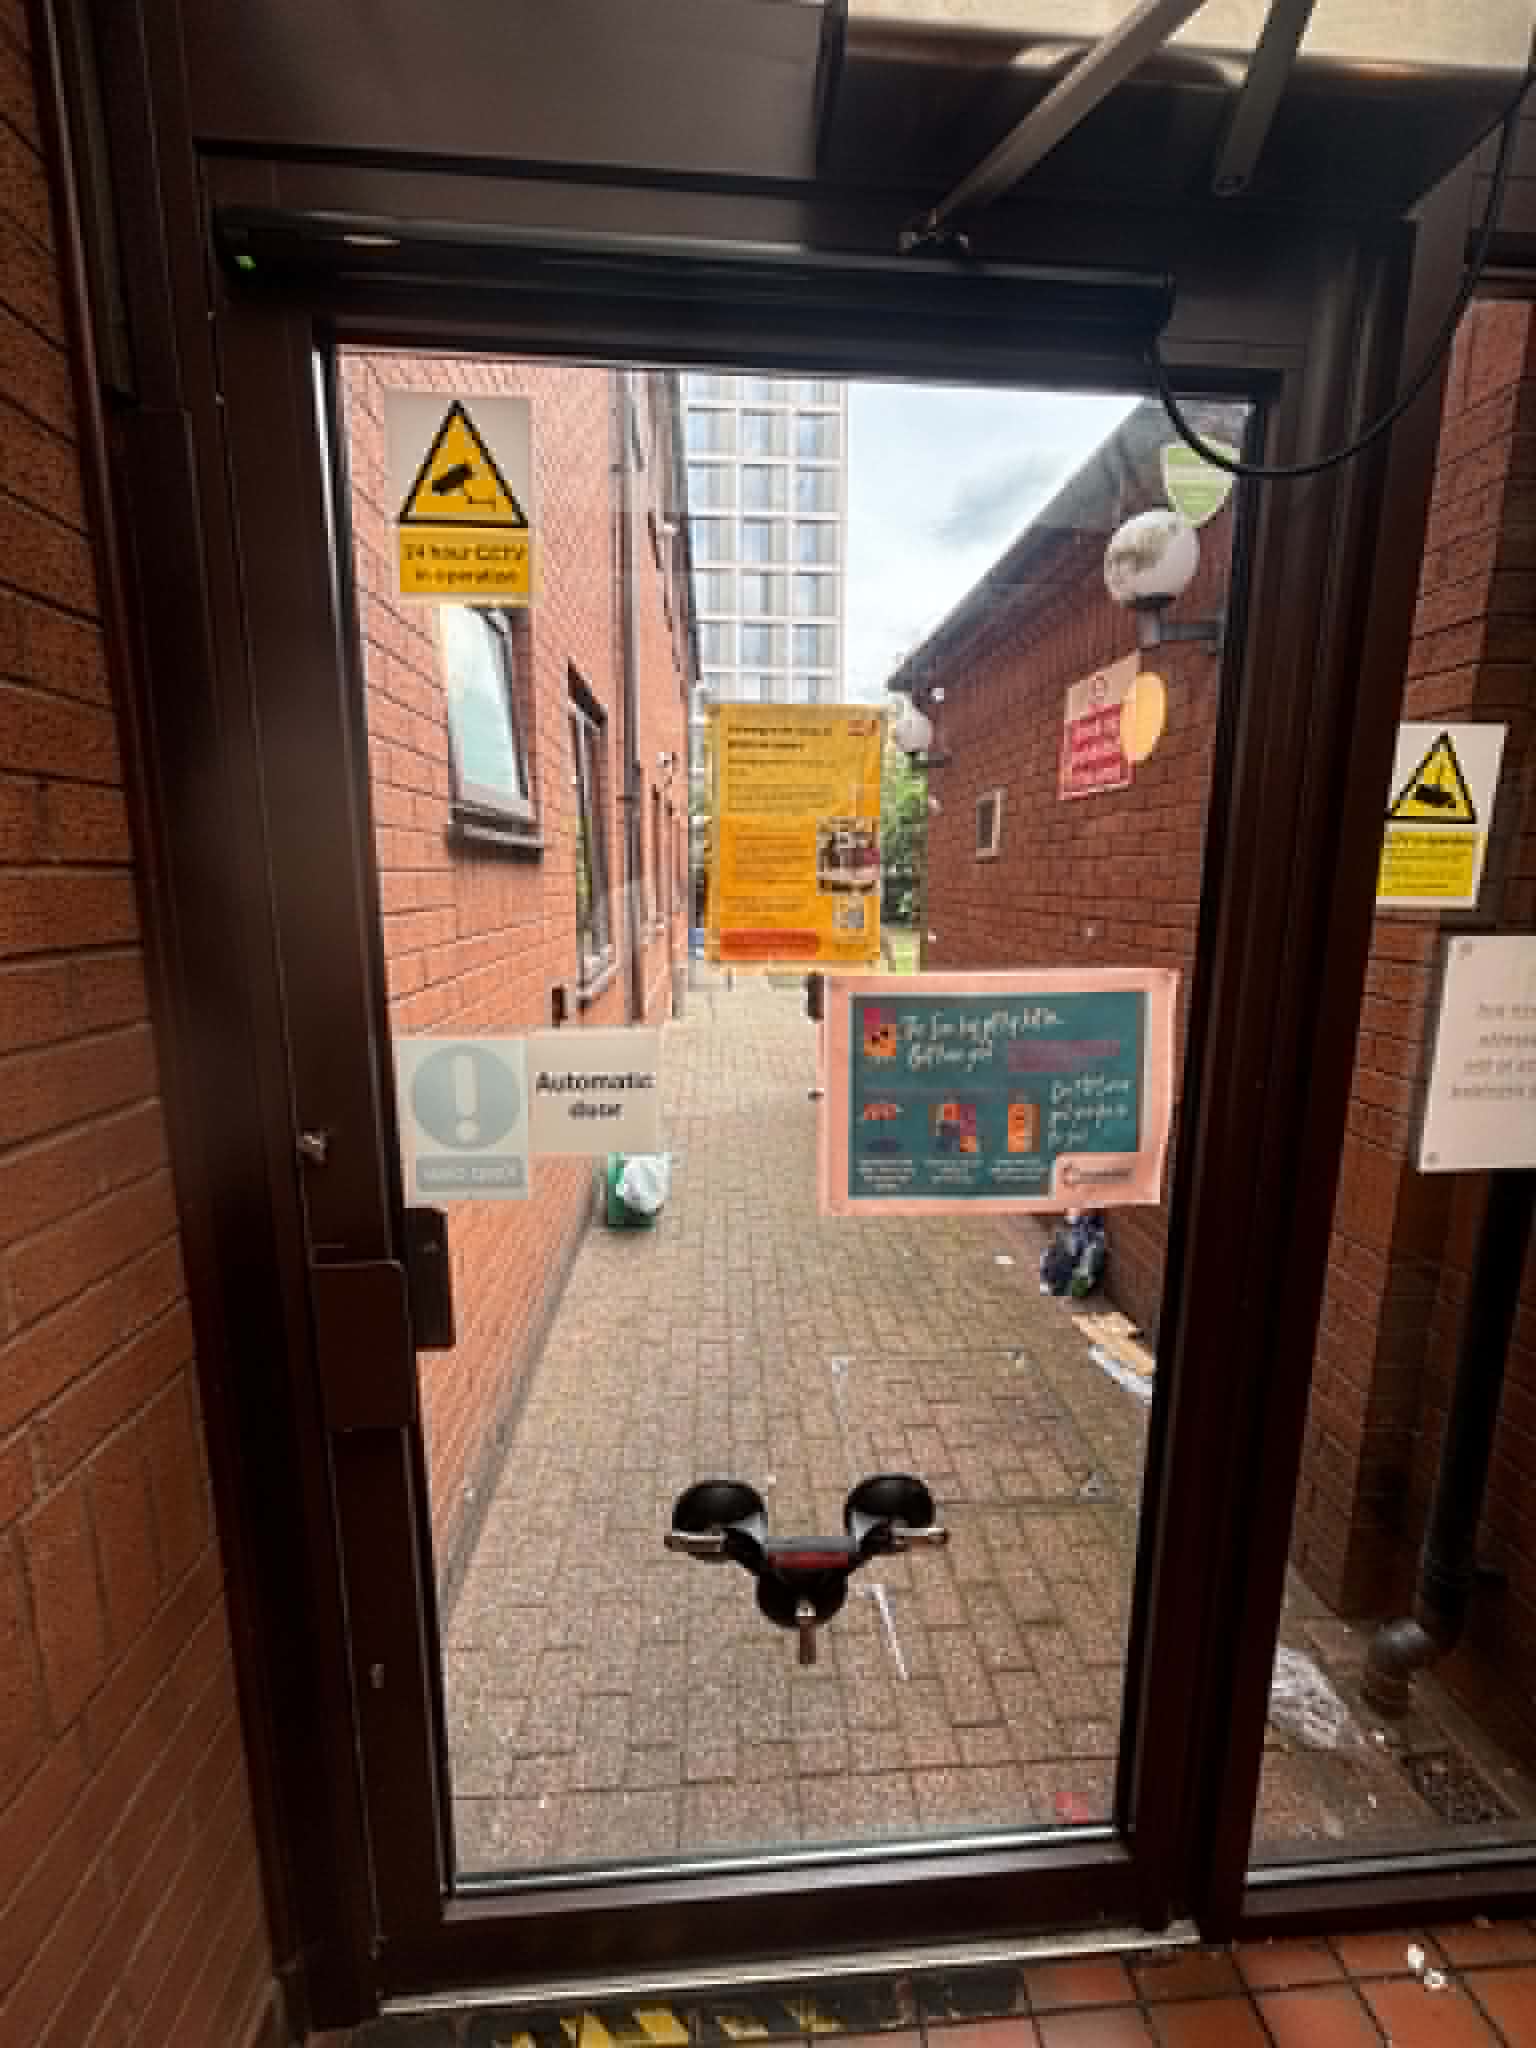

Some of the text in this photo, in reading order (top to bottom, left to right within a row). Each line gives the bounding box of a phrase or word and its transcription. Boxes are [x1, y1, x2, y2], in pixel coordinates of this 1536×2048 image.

[430, 543, 468, 561] hour
[474, 544, 527, 562] CCTV
[434, 568, 518, 584] operation
[535, 1071, 656, 1092] Automatic
[567, 1101, 624, 1119] door
